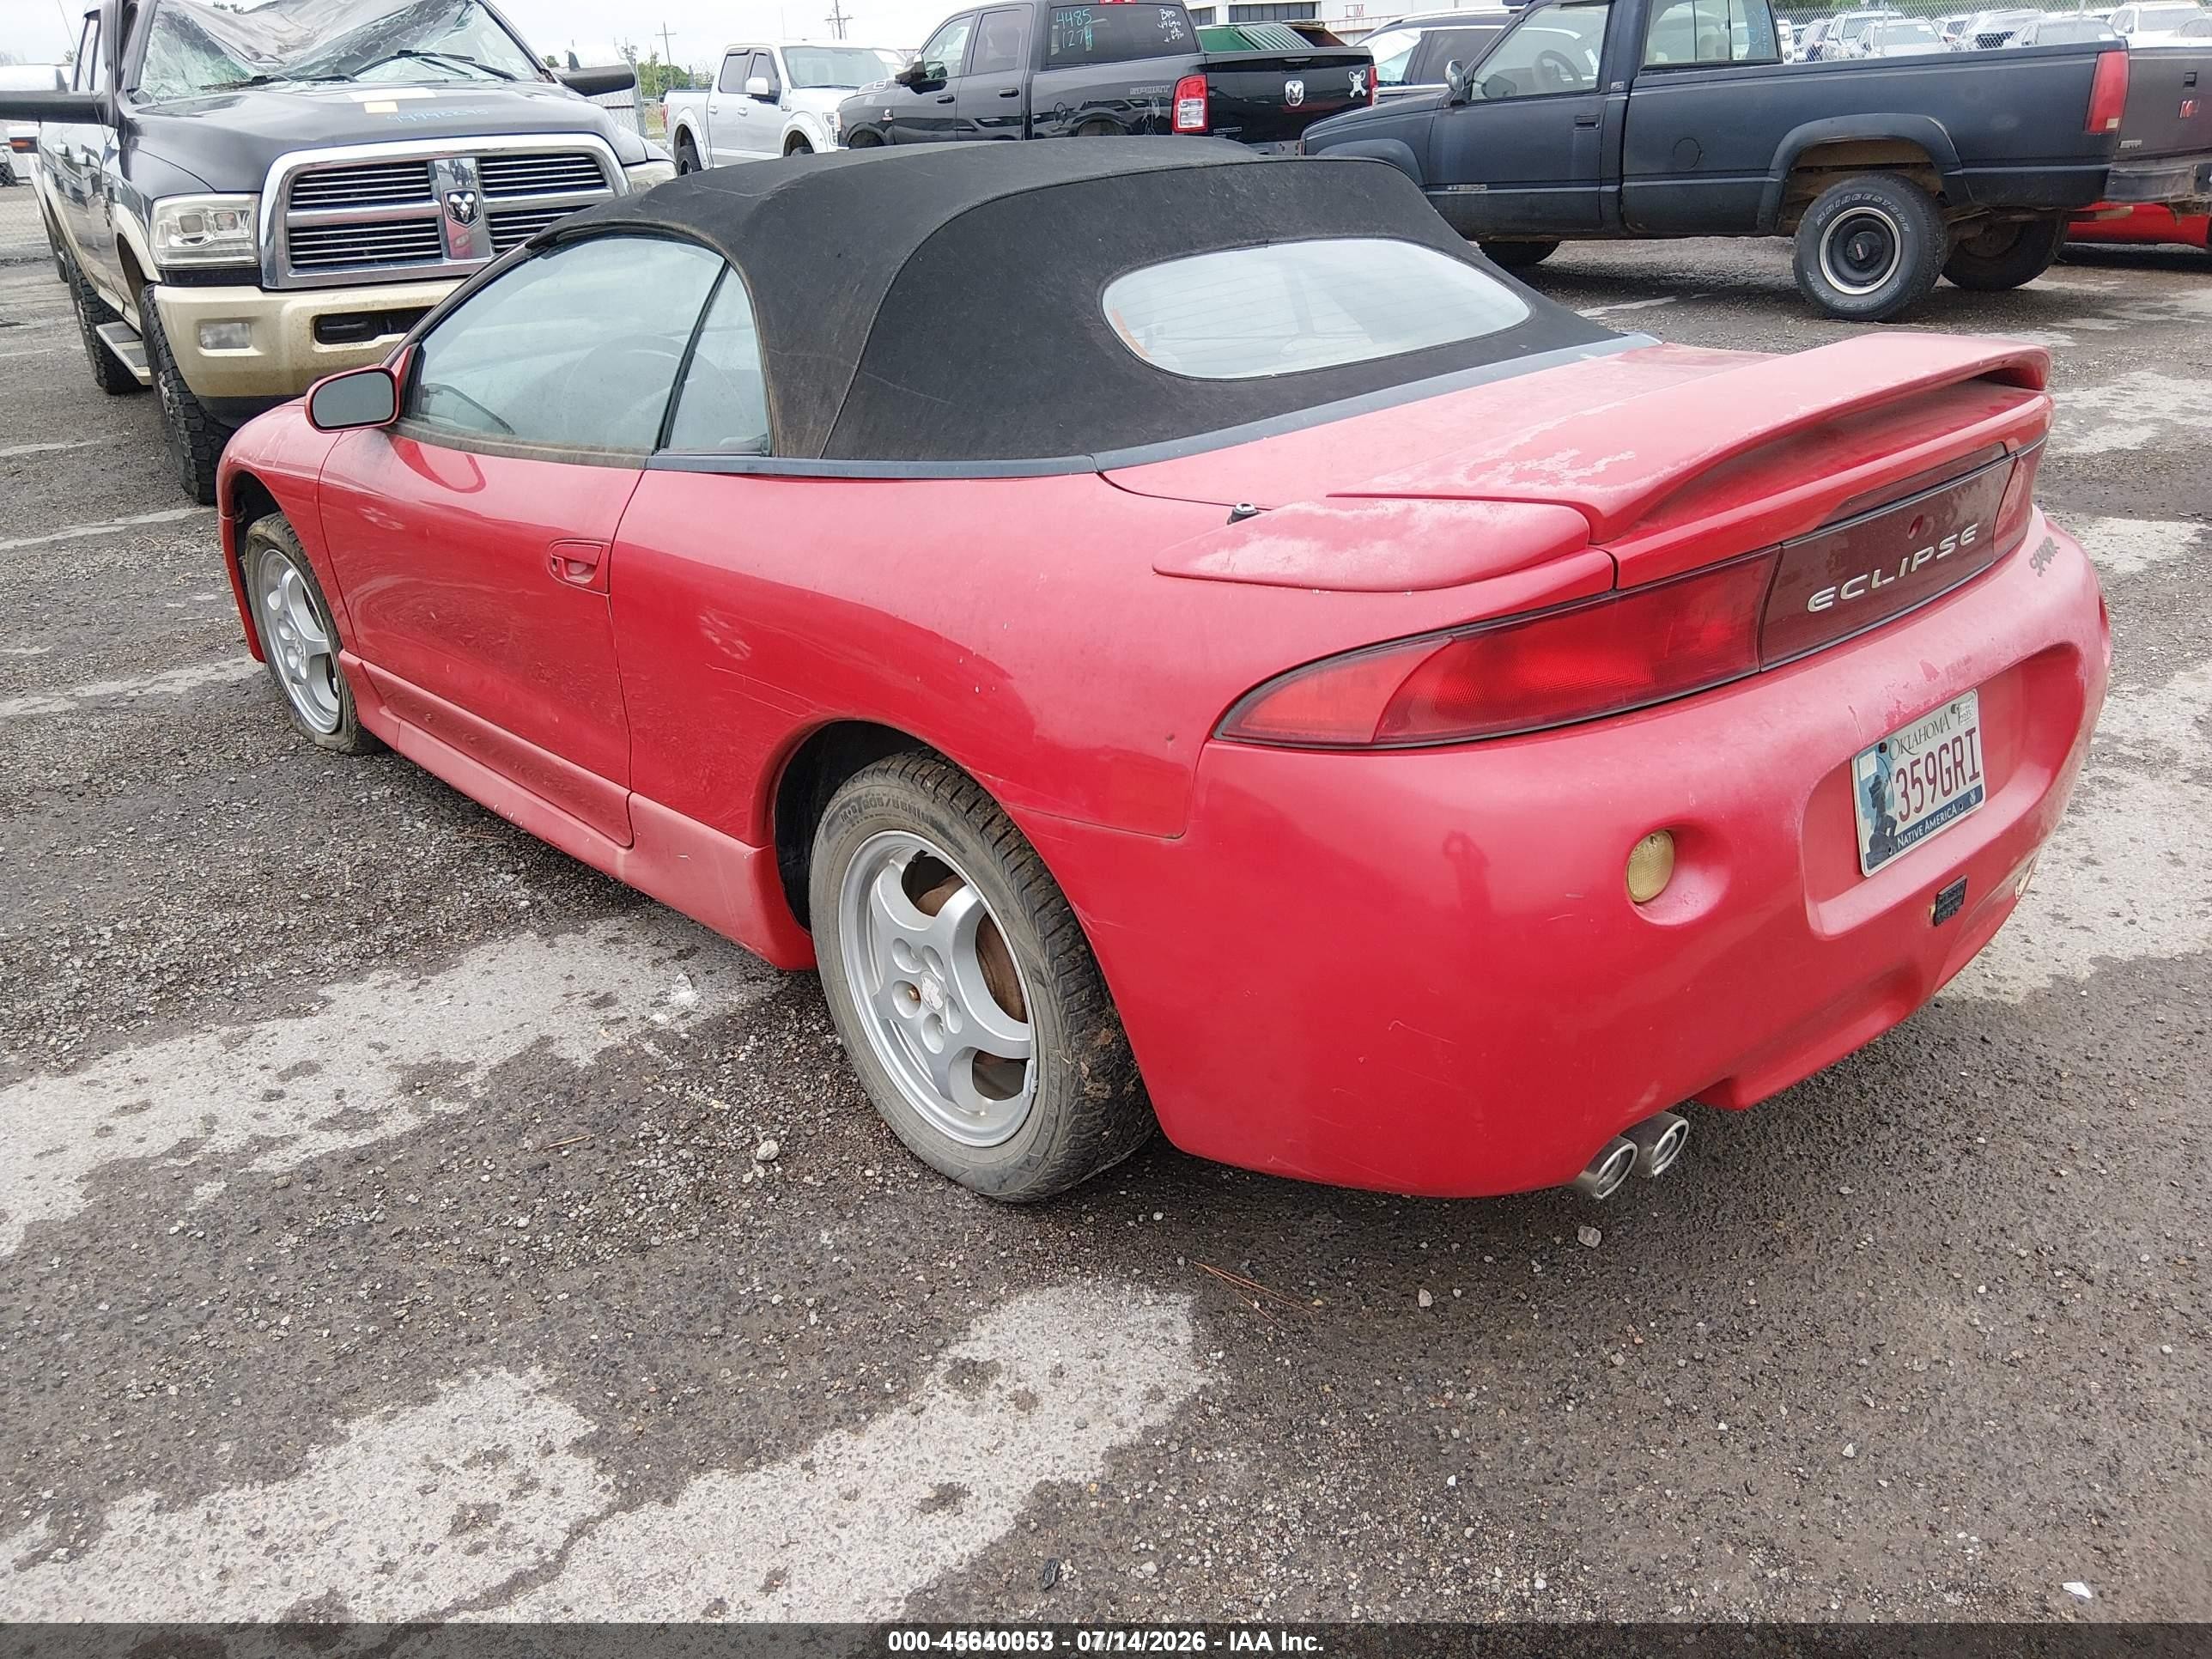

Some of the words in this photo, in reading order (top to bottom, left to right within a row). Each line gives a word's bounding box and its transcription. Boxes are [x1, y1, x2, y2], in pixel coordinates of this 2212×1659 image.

[1056, 9, 1092, 28] 4485
[1816, 193, 1910, 232] BRIDGESTONE
[1807, 523, 1978, 612] ECLIPSE
[1889, 712, 1951, 761] OKLAHOMA
[1895, 727, 1980, 823] 359GRI
[1897, 823, 1923, 849] NATIVE
[1924, 804, 1958, 832] AMERICA
